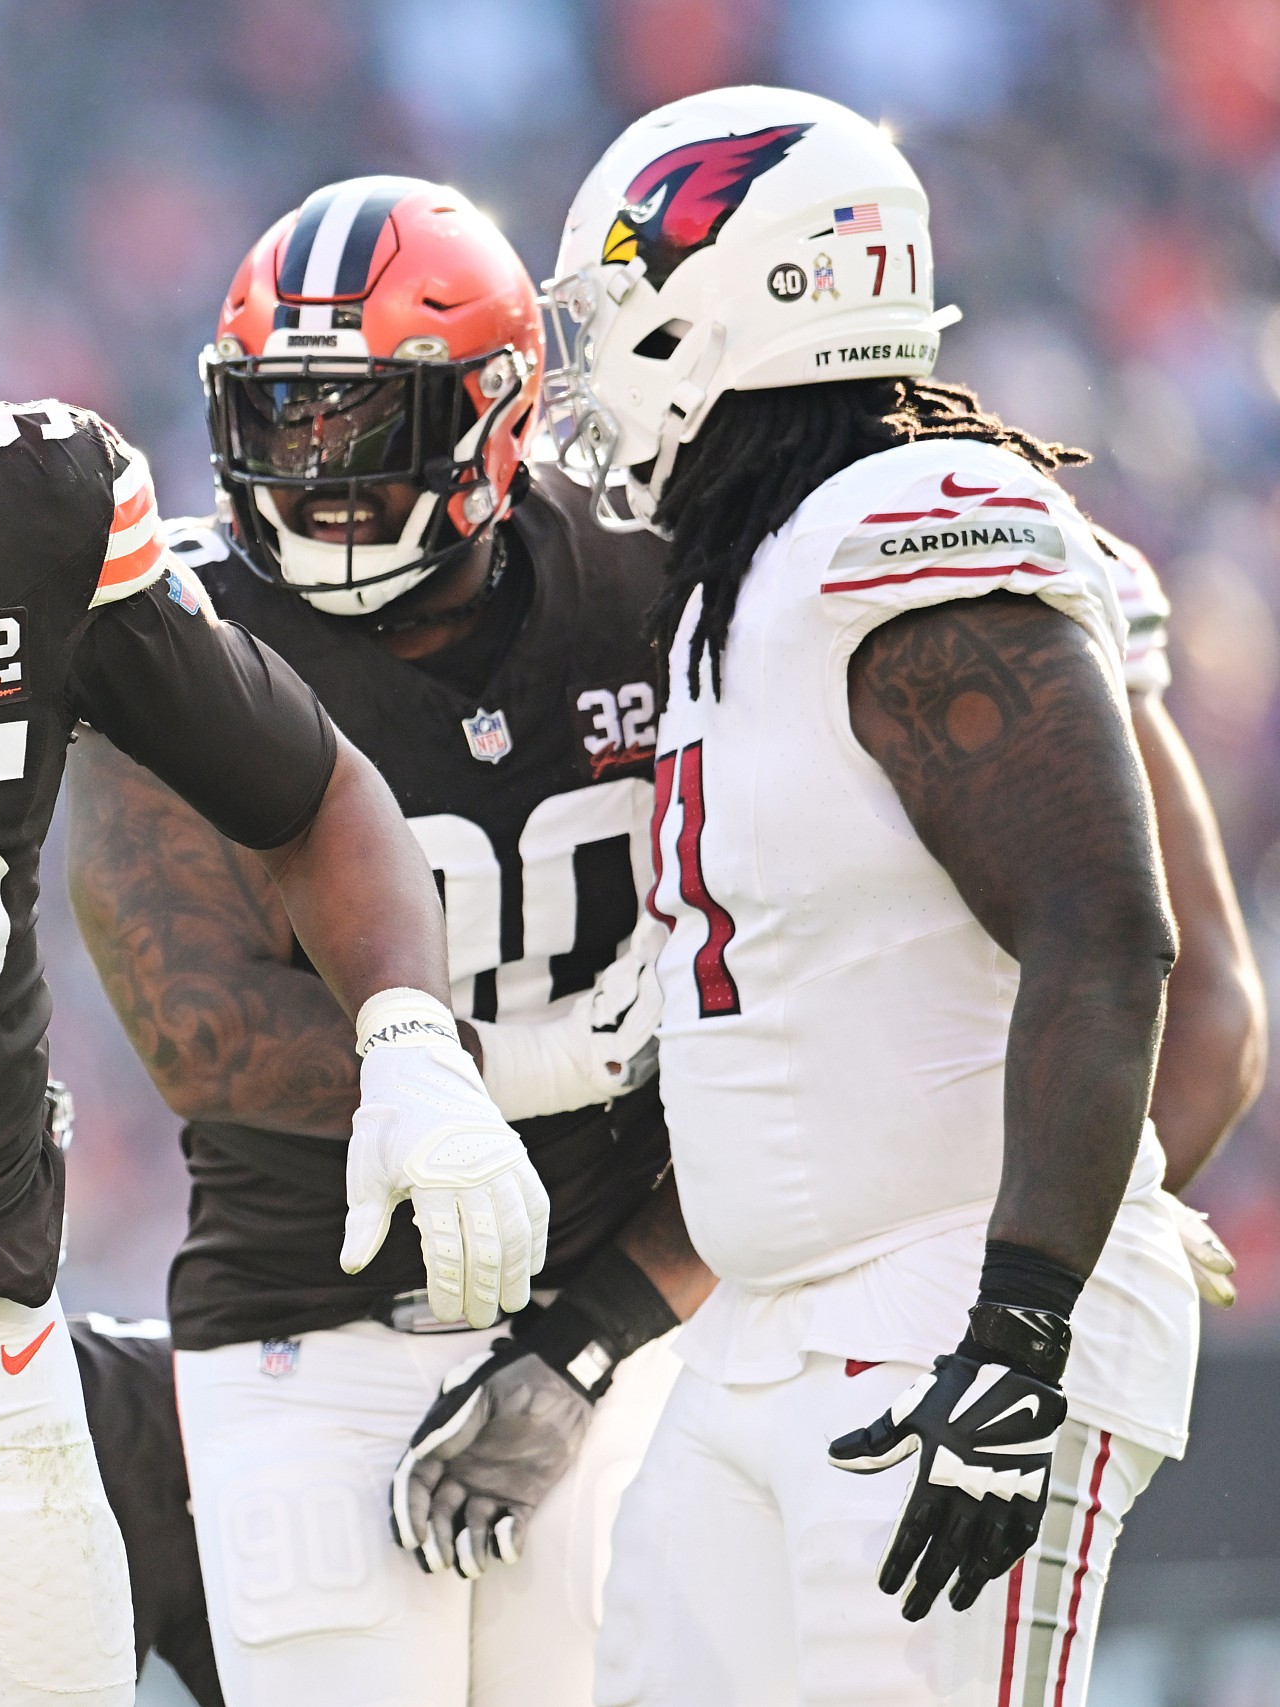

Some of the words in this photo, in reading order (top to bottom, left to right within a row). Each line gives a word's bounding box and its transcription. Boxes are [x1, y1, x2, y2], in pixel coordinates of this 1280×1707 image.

[772, 269, 802, 295] 40
[816, 276, 834, 288] NFL
[865, 244, 917, 297] 71
[287, 335, 338, 347] BROWNS
[815, 351, 832, 366] IT
[838, 345, 891, 363] TAKES
[895, 344, 916, 359] ALL
[879, 528, 1037, 556] CARDINALS
[576, 682, 656, 754] 32
[475, 732, 506, 752] NFL
